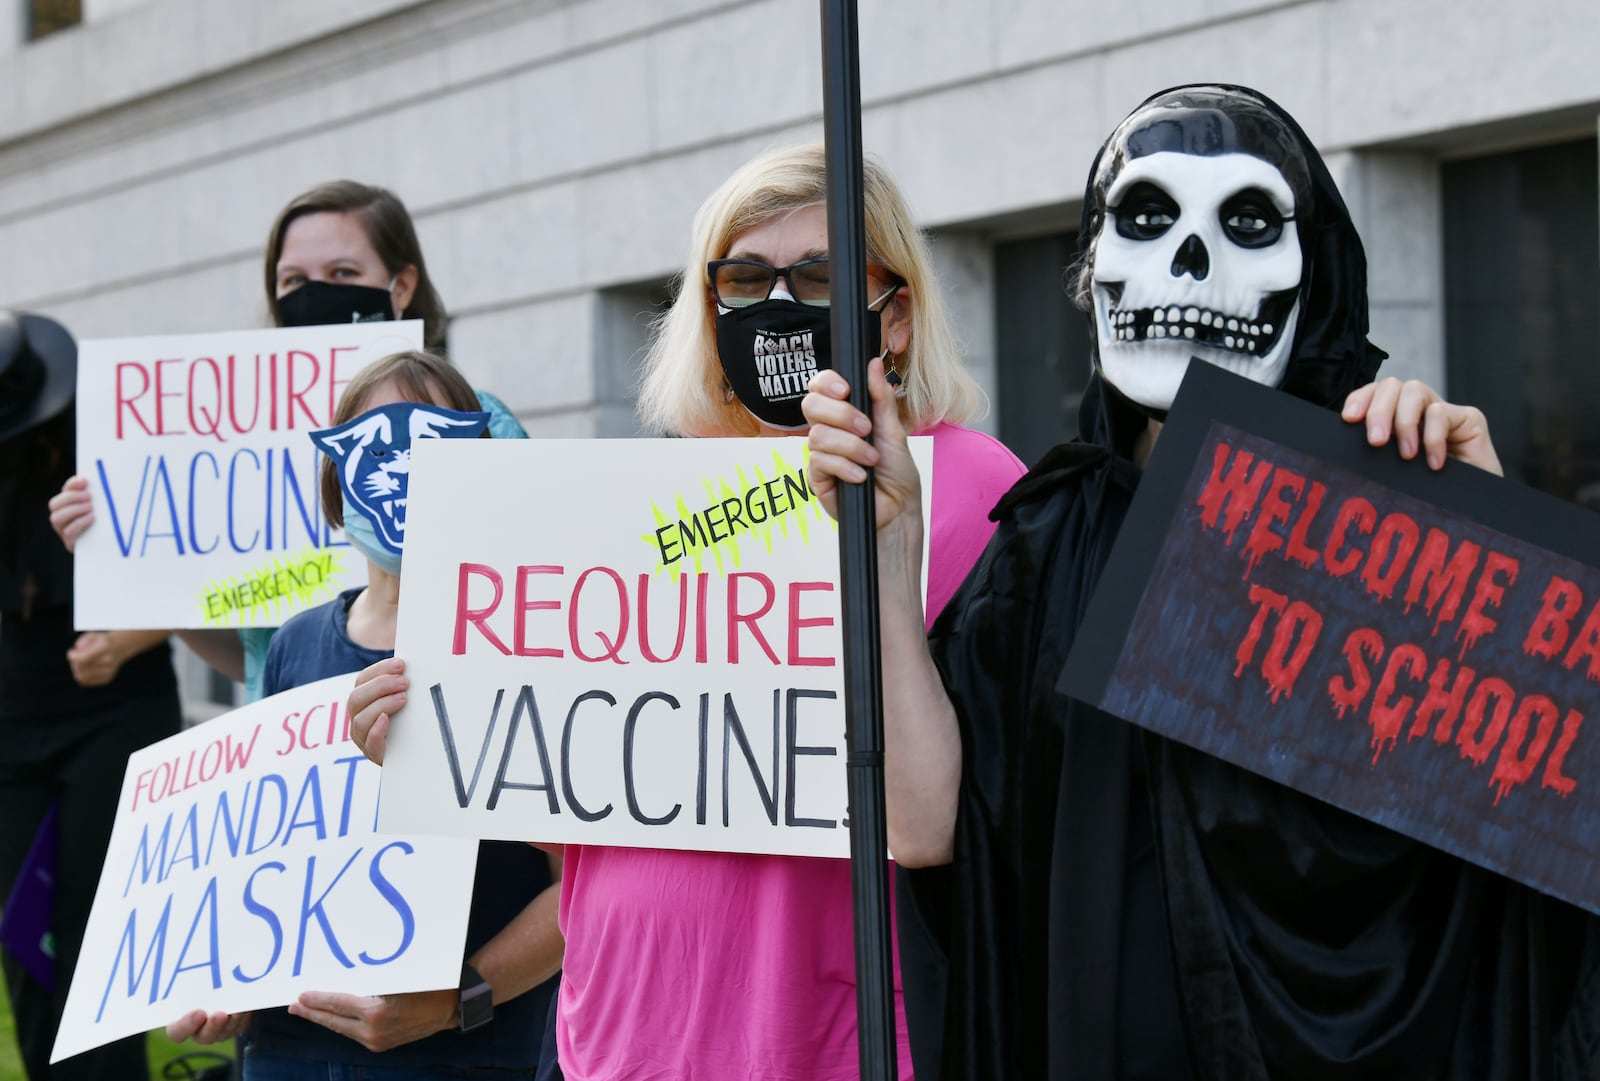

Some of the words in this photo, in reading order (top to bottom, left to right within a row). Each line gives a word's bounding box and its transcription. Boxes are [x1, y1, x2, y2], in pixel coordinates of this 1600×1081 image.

[755, 350, 817, 376] VOTERS
[655, 468, 816, 565] EMERGEN
[1197, 443, 1519, 662] WELCOME
[206, 554, 332, 619] EMERGENCY!
[452, 562, 836, 667] REQUIRE
[430, 683, 850, 829] VACCINE
[1234, 584, 1324, 705] TO
[1328, 627, 1584, 807] SCHOOL
[123, 755, 383, 898] MANDAT
[131, 724, 262, 812] FOLLOW
[95, 841, 415, 1023] MASKS
